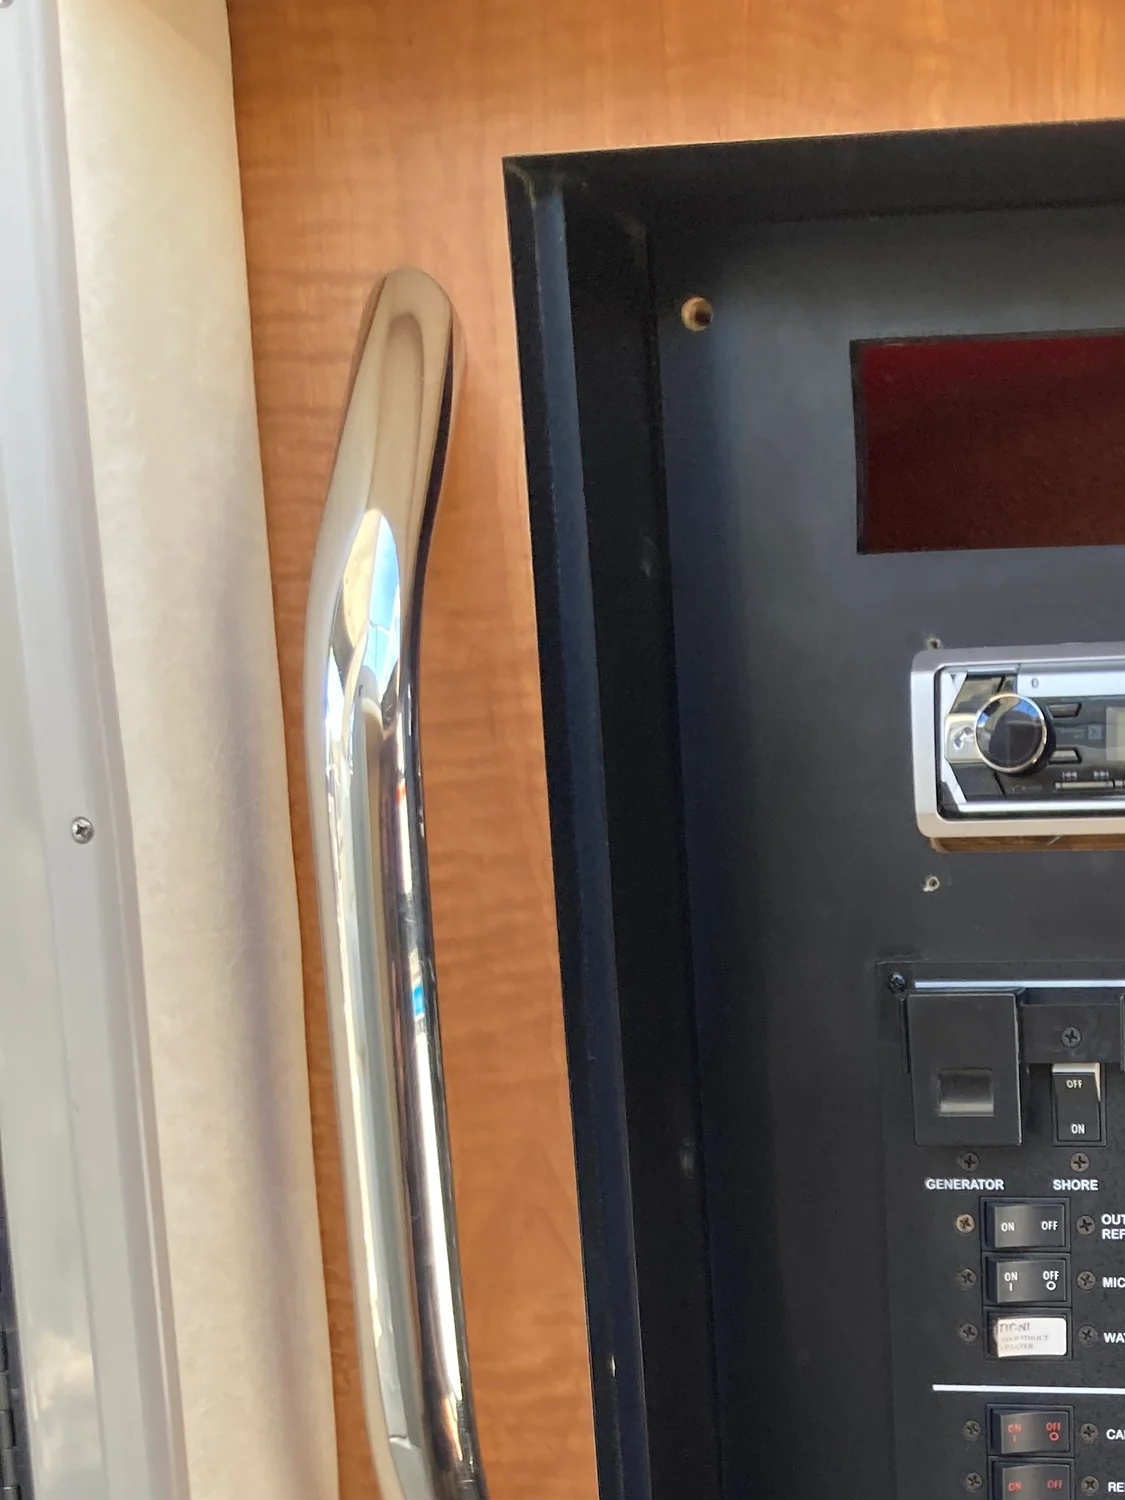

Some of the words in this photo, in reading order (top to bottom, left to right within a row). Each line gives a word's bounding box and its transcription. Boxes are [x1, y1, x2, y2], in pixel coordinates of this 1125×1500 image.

[1067, 1080, 1082, 1088] OFF
[1071, 1124, 1084, 1134] ON
[925, 1179, 1004, 1190] GENERATOR
[1053, 1179, 1098, 1190] SHORE
[1001, 1222, 1014, 1231] ON
[1041, 1221, 1057, 1230] OFF
[1004, 1272, 1017, 1281] ON
[1043, 1271, 1059, 1280] OFF
[1008, 1424, 1021, 1433] ON
[1046, 1422, 1060, 1431] OFF
[1009, 1482, 1022, 1491] ON
[1047, 1480, 1062, 1488] OFF
